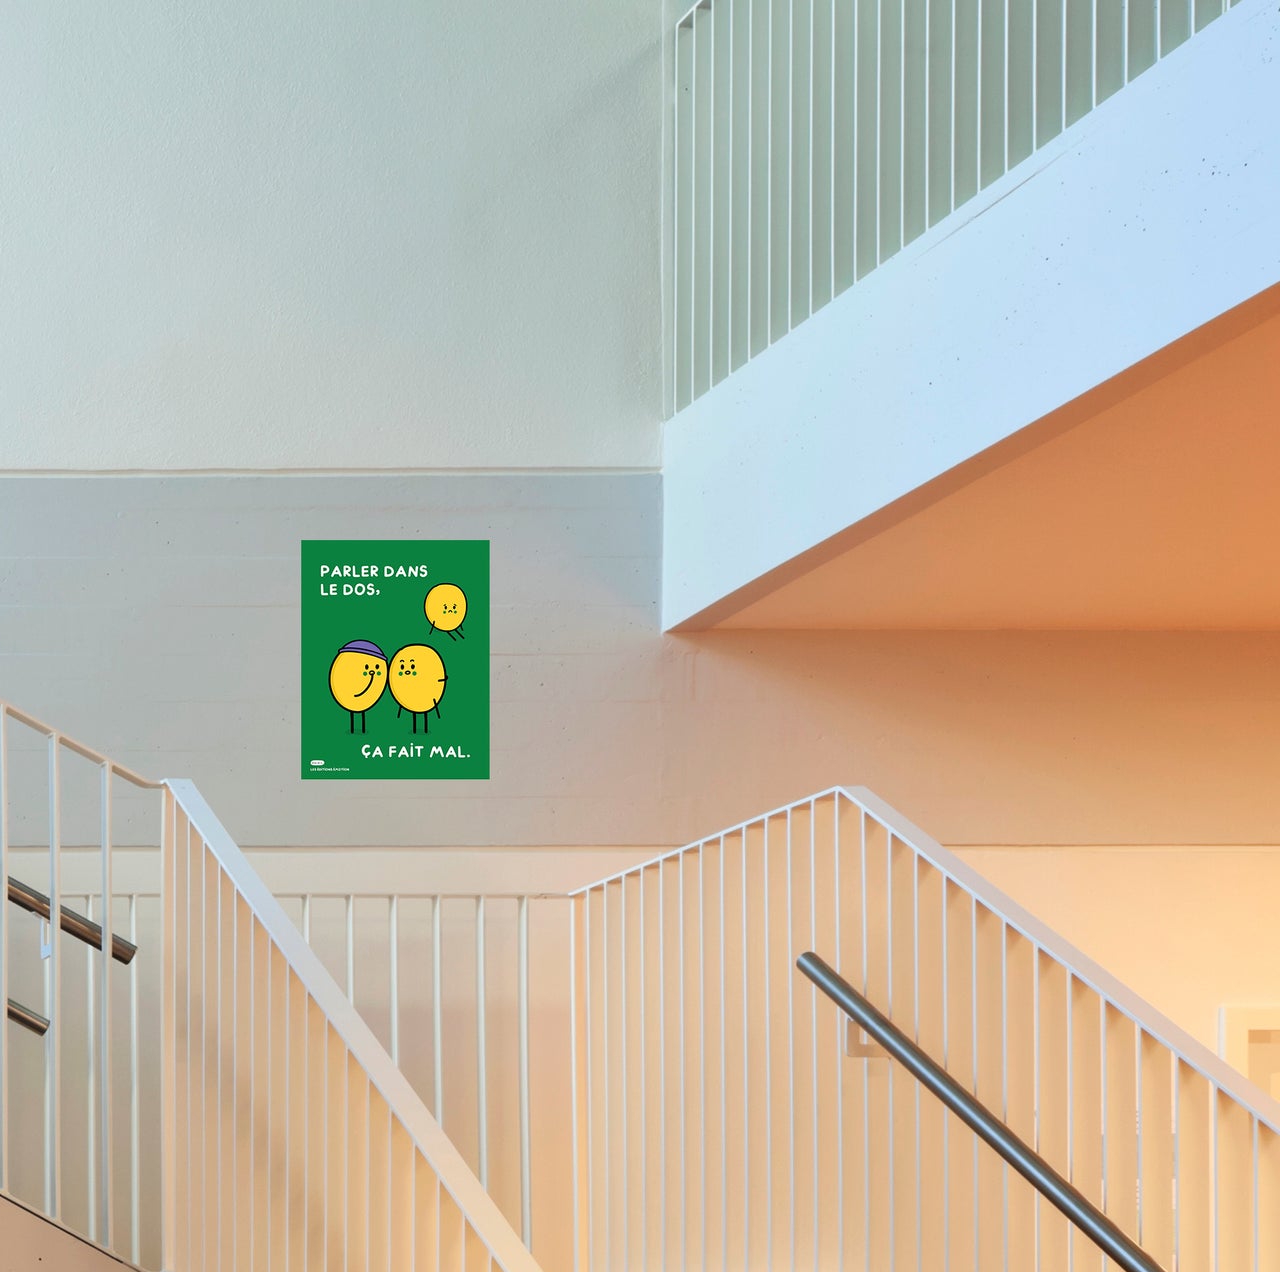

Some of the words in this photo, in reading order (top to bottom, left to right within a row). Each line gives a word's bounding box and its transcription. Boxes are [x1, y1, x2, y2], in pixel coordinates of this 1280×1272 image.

[320, 564, 379, 578] PARLER
[383, 564, 428, 578] DANS
[320, 583, 338, 596] LE
[342, 583, 381, 596] DOS,
[361, 744, 384, 759] ÇA
[429, 745, 471, 759] MAL.
